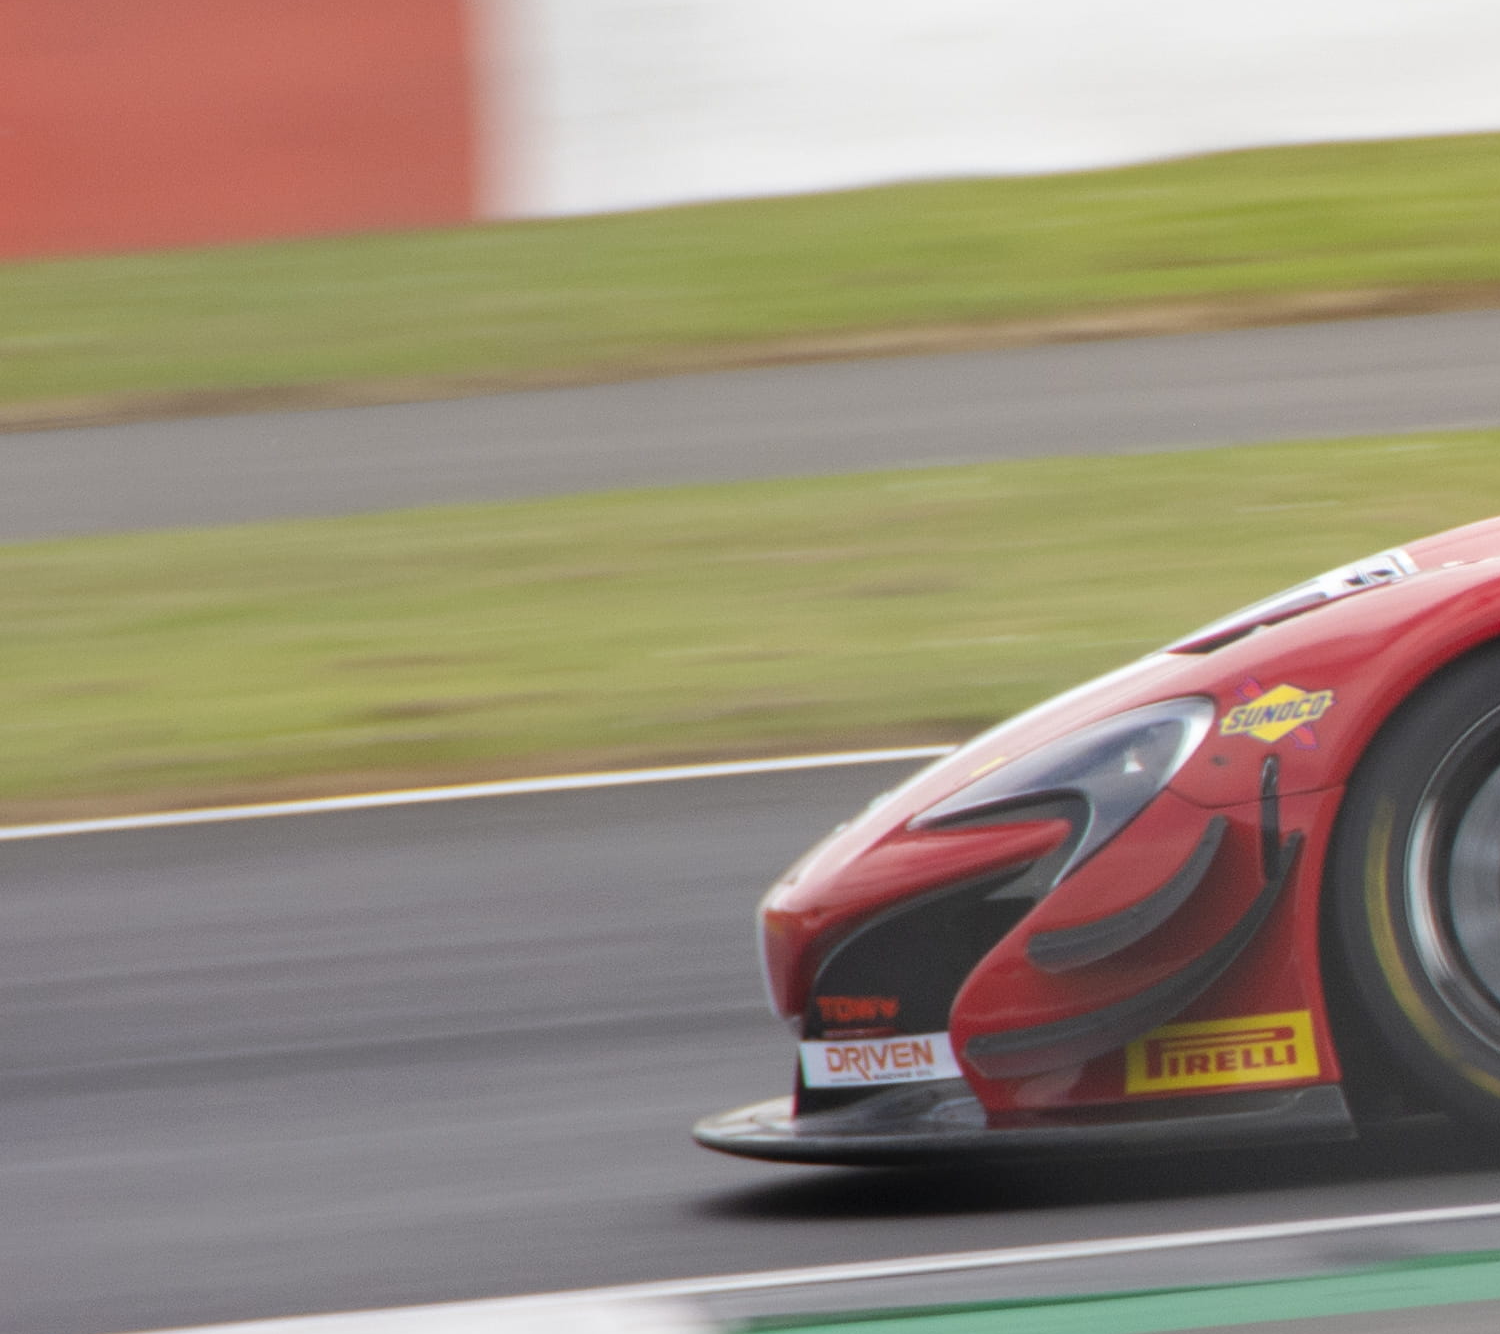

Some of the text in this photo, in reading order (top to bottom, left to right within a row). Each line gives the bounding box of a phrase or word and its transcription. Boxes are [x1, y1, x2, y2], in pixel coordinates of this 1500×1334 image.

[1225, 694, 1329, 731] SUNOCO
[825, 1041, 934, 1081] DRIVEN
[1145, 1027, 1296, 1079] PIRELLI
